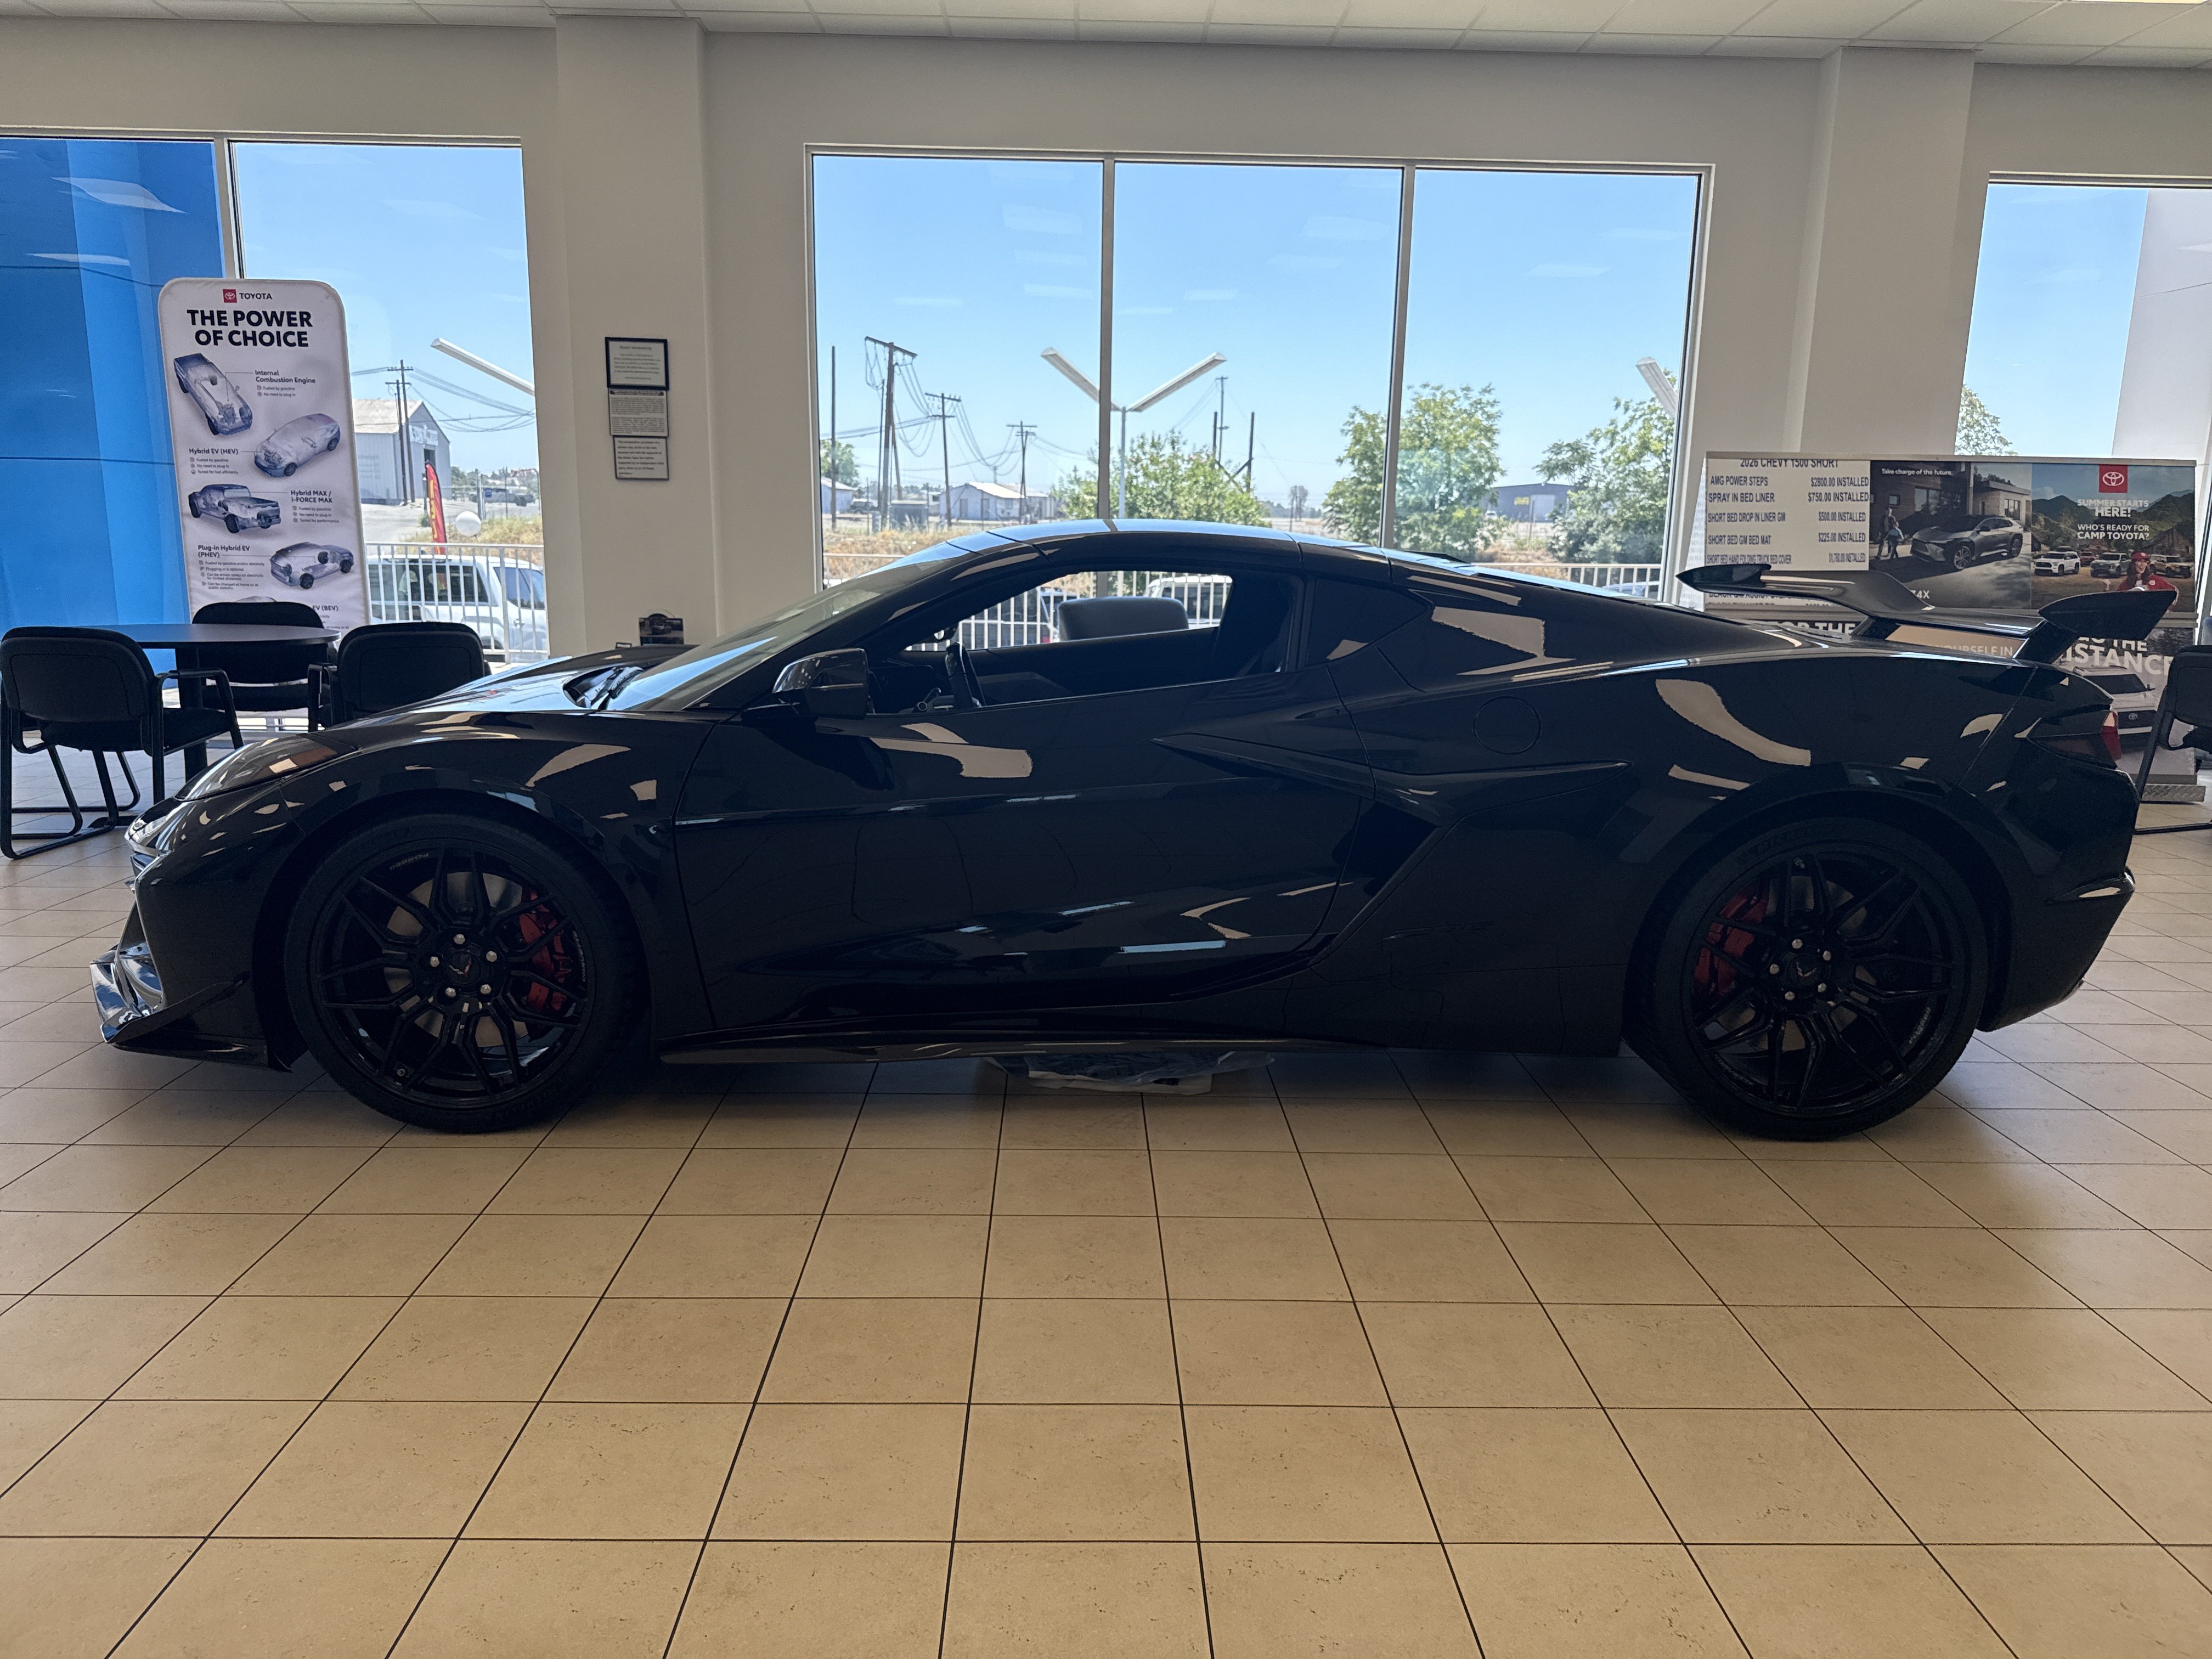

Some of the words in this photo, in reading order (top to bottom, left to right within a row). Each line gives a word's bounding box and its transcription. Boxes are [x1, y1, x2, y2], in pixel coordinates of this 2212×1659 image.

[187, 309, 228, 326] THE
[233, 311, 313, 328] POWER
[195, 330, 223, 346] OF
[228, 330, 309, 347] CHOICE
[1740, 459, 1758, 468] 2026
[1760, 459, 1788, 468] CHEVY
[1791, 459, 1809, 468] 1500
[1810, 459, 1838, 468] SHORT
[1710, 475, 1724, 486] AMG
[1725, 476, 1747, 486] POWER
[1748, 476, 1768, 487] STEPS
[1837, 477, 1869, 487] INSTALLED
[1708, 492, 1730, 503] SPRAY
[1731, 493, 1739, 503] IN
[1740, 493, 1754, 503] BED
[1755, 493, 1775, 503] LINER
[1833, 492, 1869, 502] INSTALLED
[1708, 512, 1726, 522] SHORT
[1726, 512, 1737, 522] BED
[1739, 512, 1753, 522] DROP
[1754, 512, 1760, 522] IN
[1760, 512, 1776, 522] LINER
[1778, 512, 1786, 522] GM
[1838, 511, 1866, 522] INSTALLED
[2095, 506, 2132, 517] HERE!
[1708, 535, 1726, 545] SHORT
[1728, 535, 1738, 545] BED
[1739, 535, 1747, 545] GM
[1748, 535, 1759, 545] BED
[1760, 535, 1771, 545] MAT
[1838, 532, 1866, 543] INSTALLED
[2077, 531, 2106, 539] CAMP
[2107, 532, 2150, 540] TOYOTA?
[2000, 645, 2013, 657] IN
